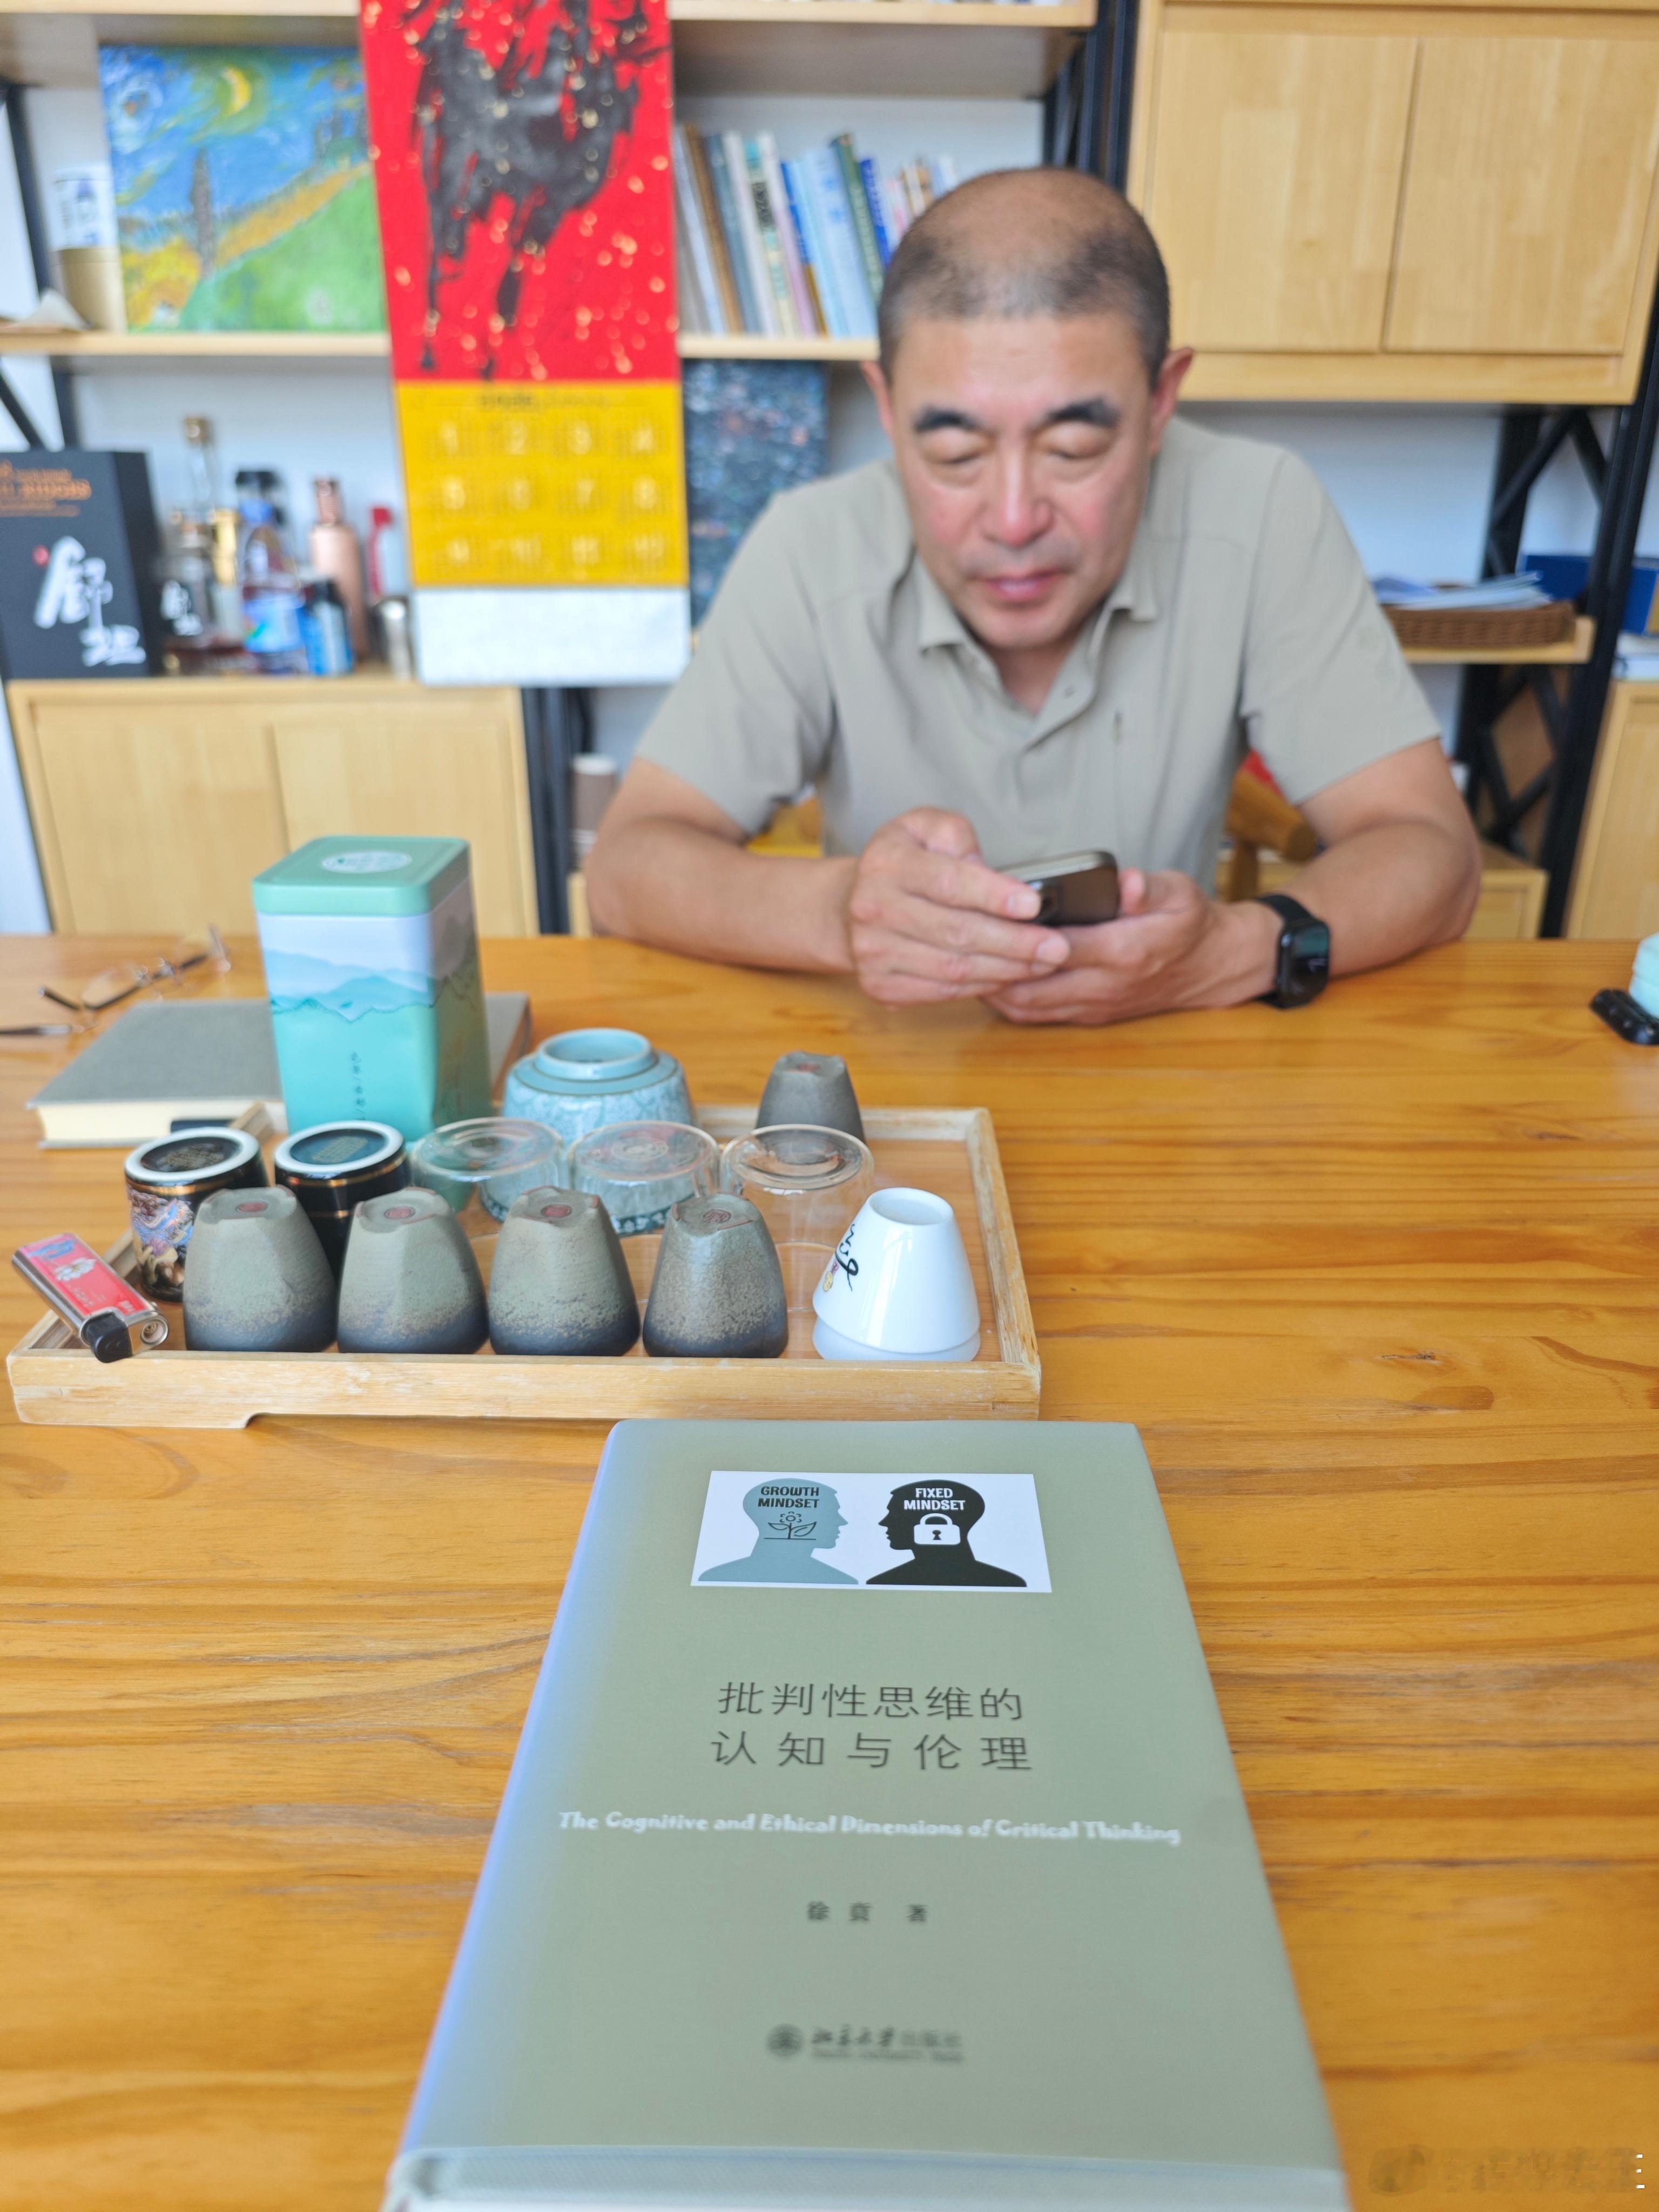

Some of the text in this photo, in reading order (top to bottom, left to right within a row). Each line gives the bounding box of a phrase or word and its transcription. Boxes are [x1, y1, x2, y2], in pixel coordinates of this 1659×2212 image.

[760, 1486, 819, 1496] GROWTH
[915, 1488, 953, 1498] FIXED
[758, 1498, 819, 1508] MINDSET
[903, 1500, 966, 1510] MINDSET
[718, 1681, 1023, 1721] 批判性思维的
[711, 1730, 1033, 1771] 认知与伦理
[559, 1811, 1181, 1846] The Cognitive and Ethical Dimensions of Critical Thinking
